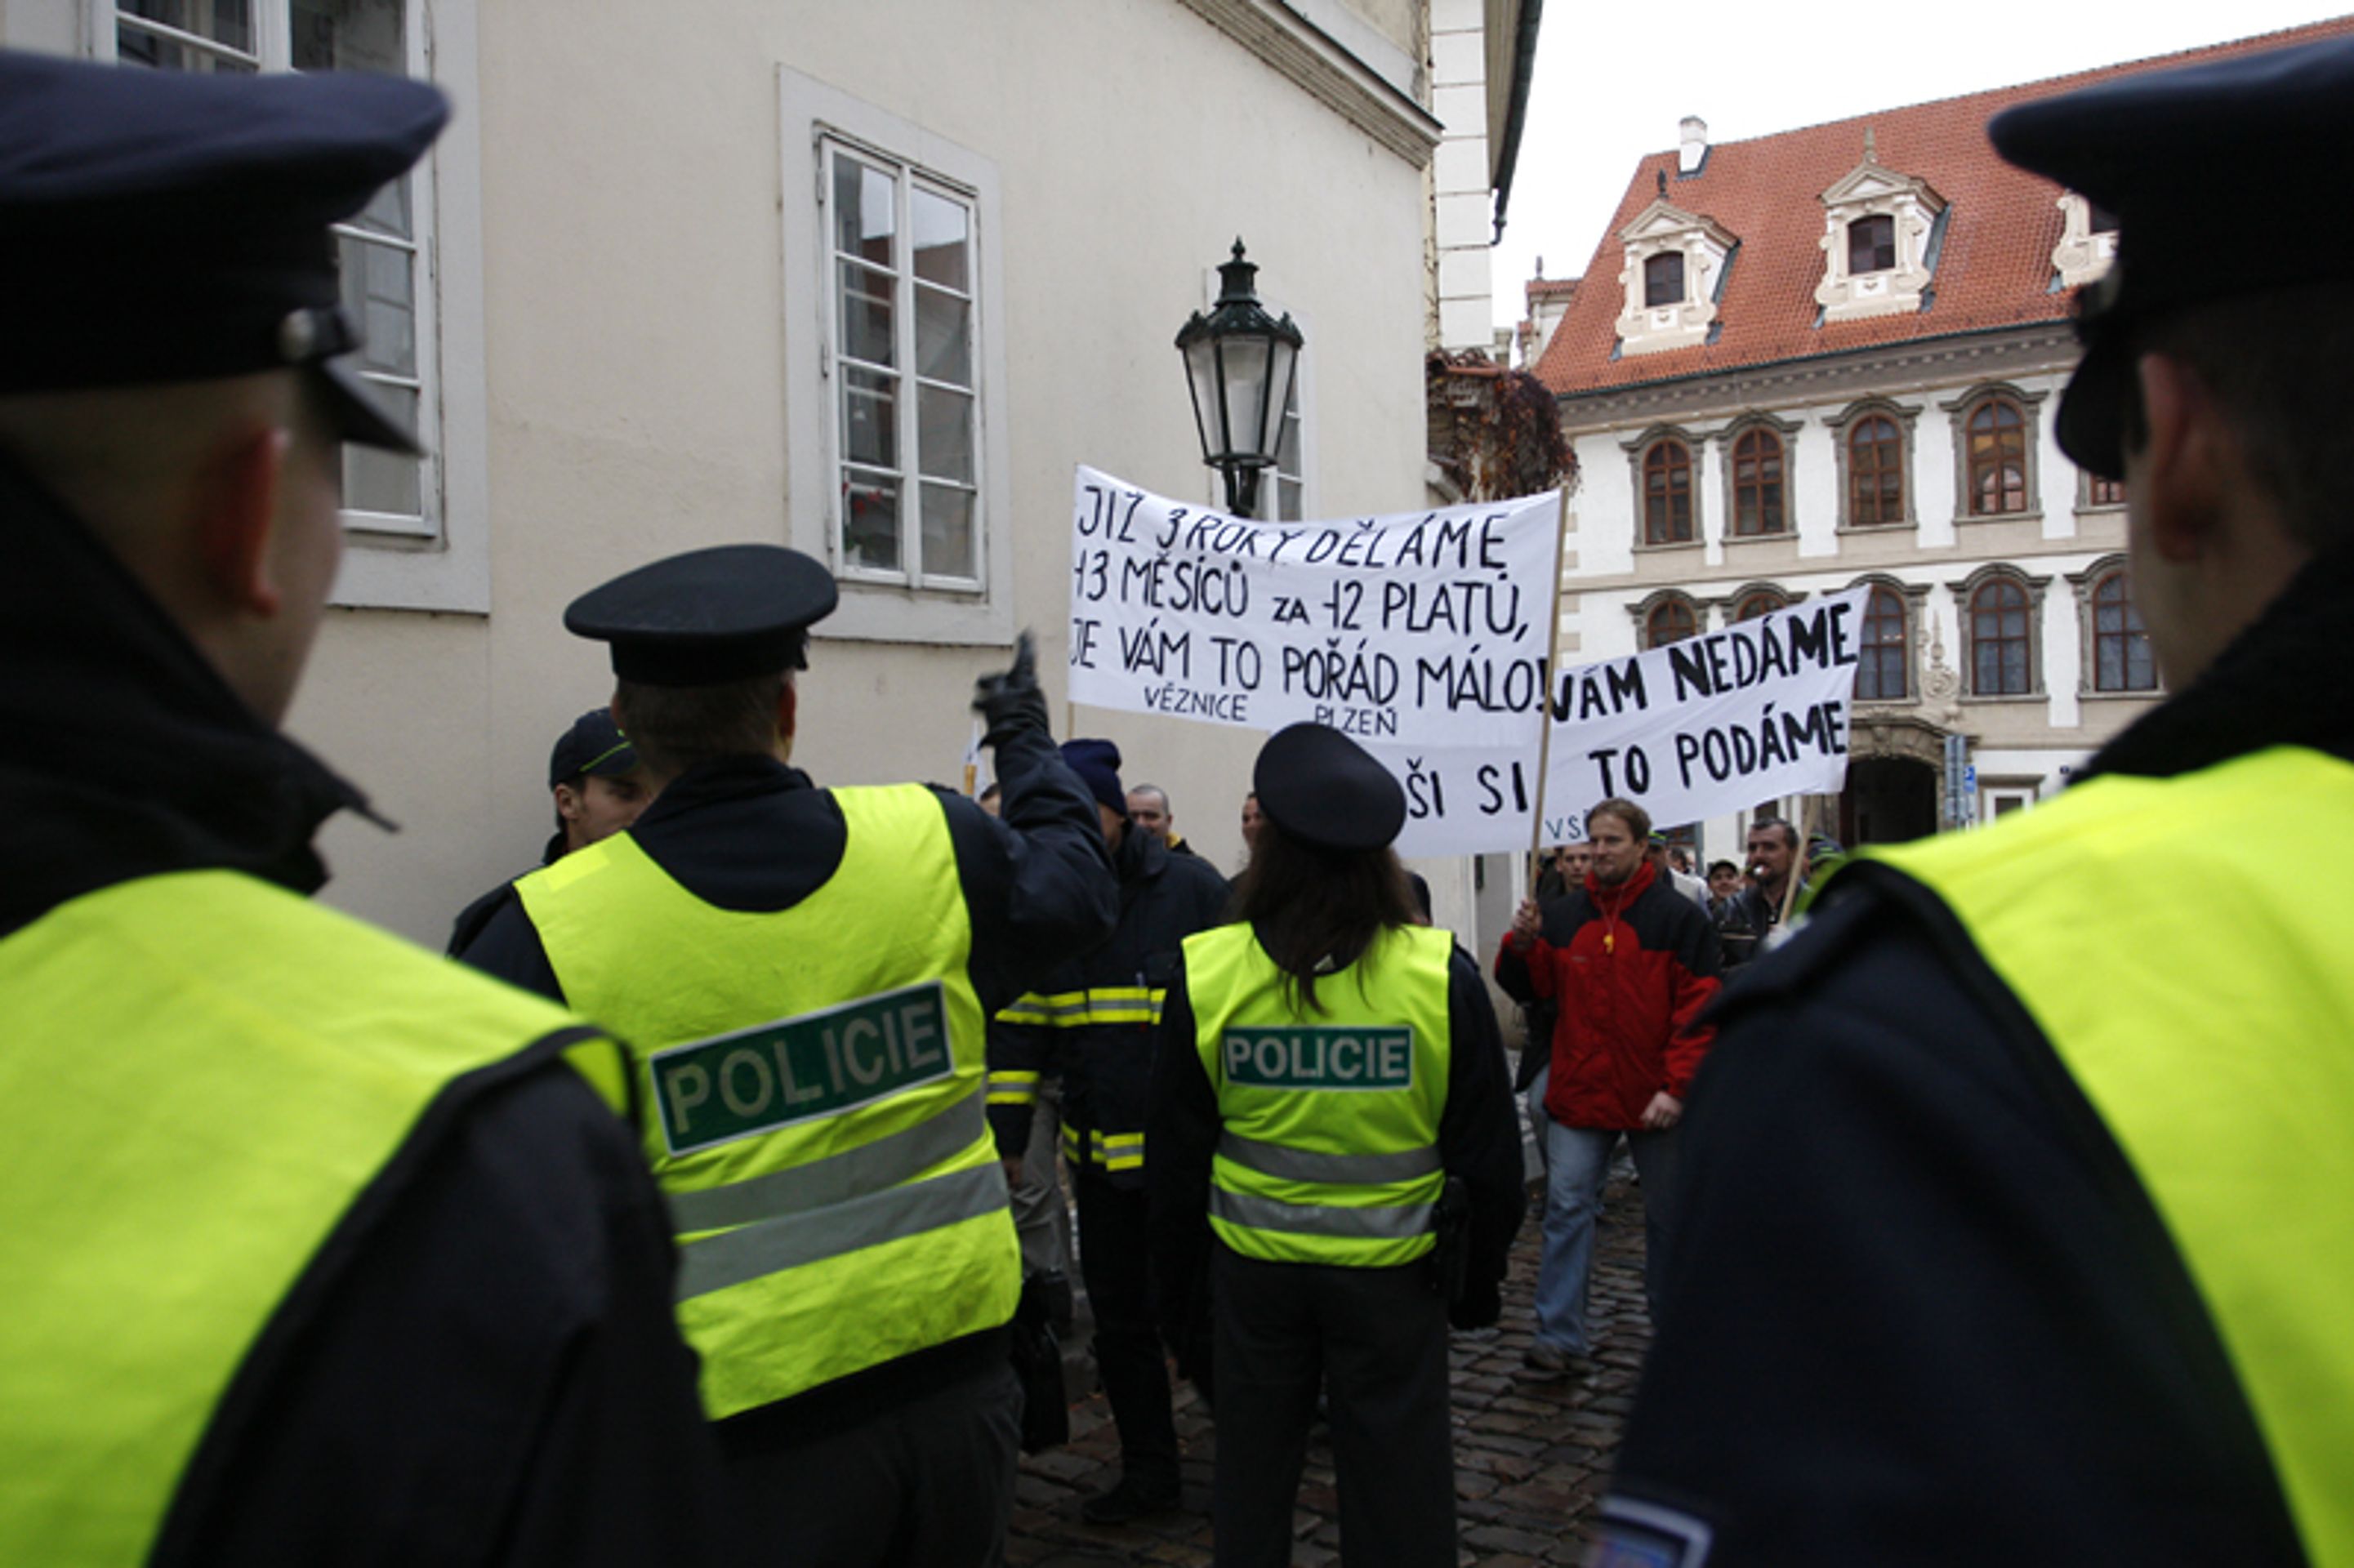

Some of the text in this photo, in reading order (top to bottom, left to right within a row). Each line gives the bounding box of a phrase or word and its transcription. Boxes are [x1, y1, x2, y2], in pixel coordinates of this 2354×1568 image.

[1157, 508, 1188, 549] 3
[1185, 514, 1304, 562] ROKY
[1304, 513, 1508, 568] DĚLÁME
[1074, 549, 1528, 643] 13 MĚSÍCŮ ZA 12 PLATŮ,
[1071, 617, 1101, 669] JE
[1119, 617, 1190, 679] VÁM
[1209, 636, 1261, 691] TO
[1283, 637, 1398, 705] POŘÁD
[1669, 603, 1858, 702] NEDÁME
[1477, 761, 1528, 815] SI
[1588, 744, 1650, 799] TO
[1676, 701, 1846, 790] PODÁME
[664, 1001, 941, 1134] POLICIE
[1226, 1036, 1407, 1079] POLICIE
